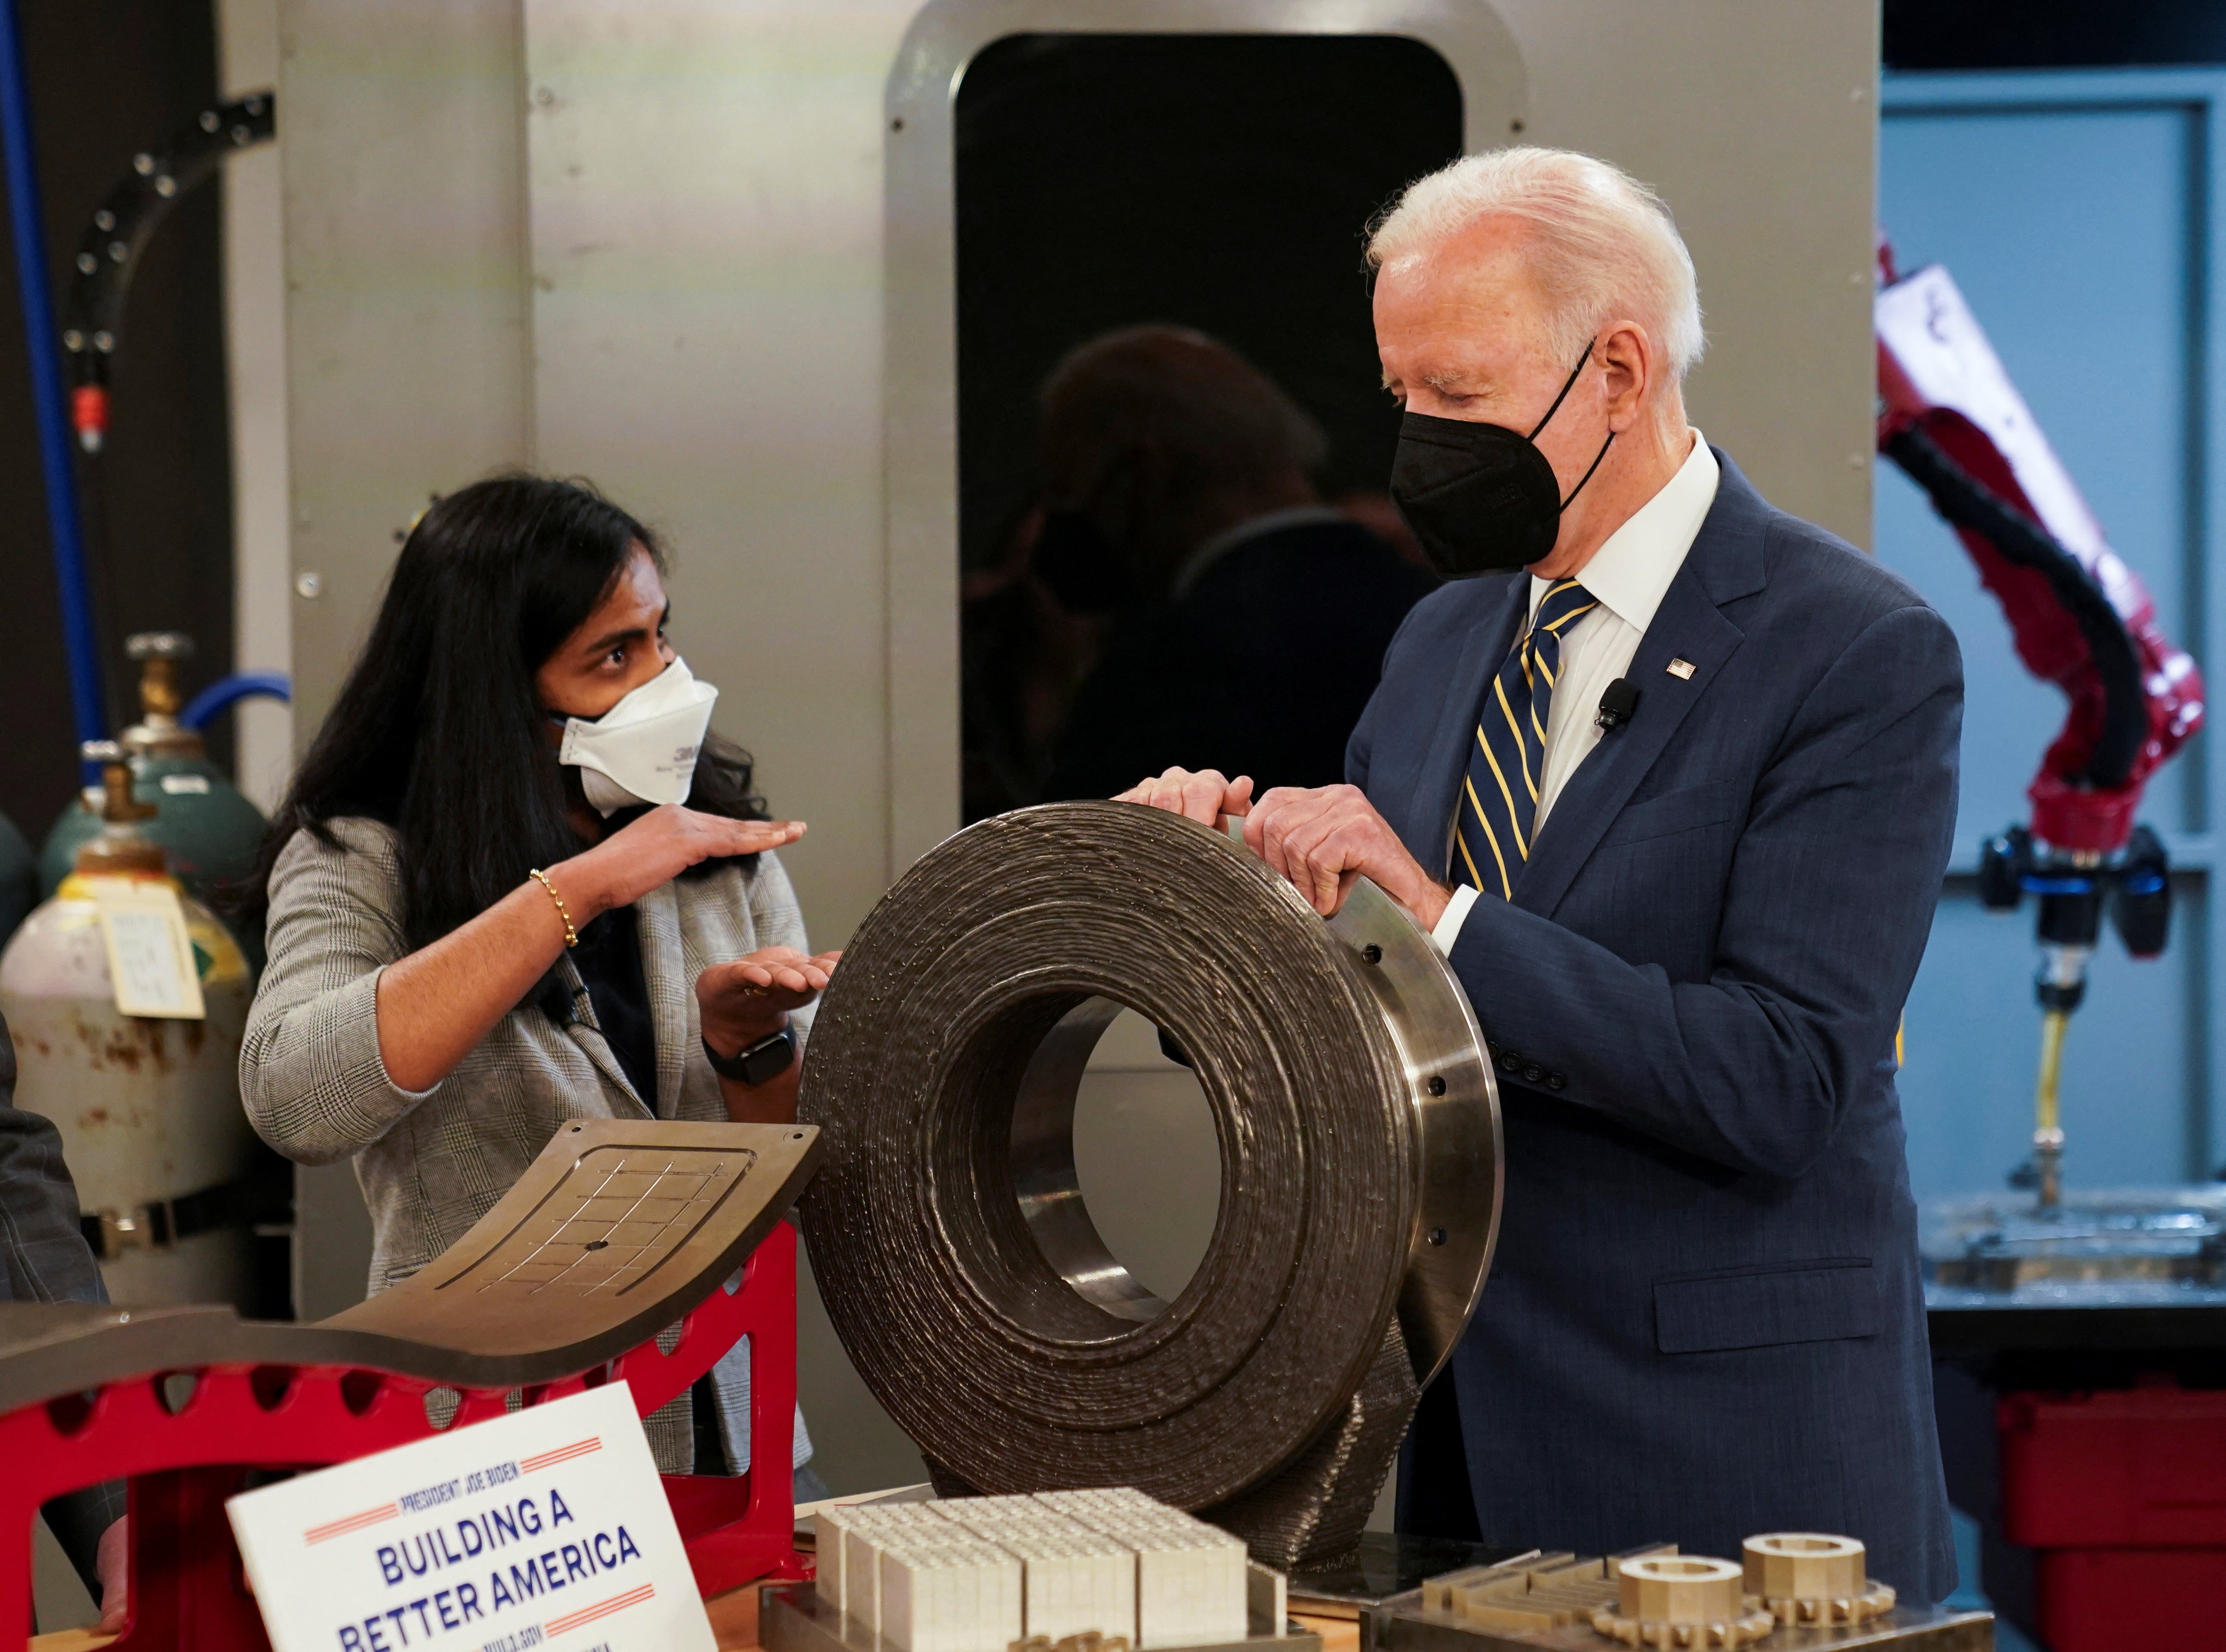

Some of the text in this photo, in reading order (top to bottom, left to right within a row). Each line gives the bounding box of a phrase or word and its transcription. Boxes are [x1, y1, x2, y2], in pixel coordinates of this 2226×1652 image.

[401, 1461, 518, 1512] PRESIDENT JOE BIDEN
[377, 1489, 574, 1586] BUILDING A
[338, 1525, 641, 1652] BETTER AMERICA
